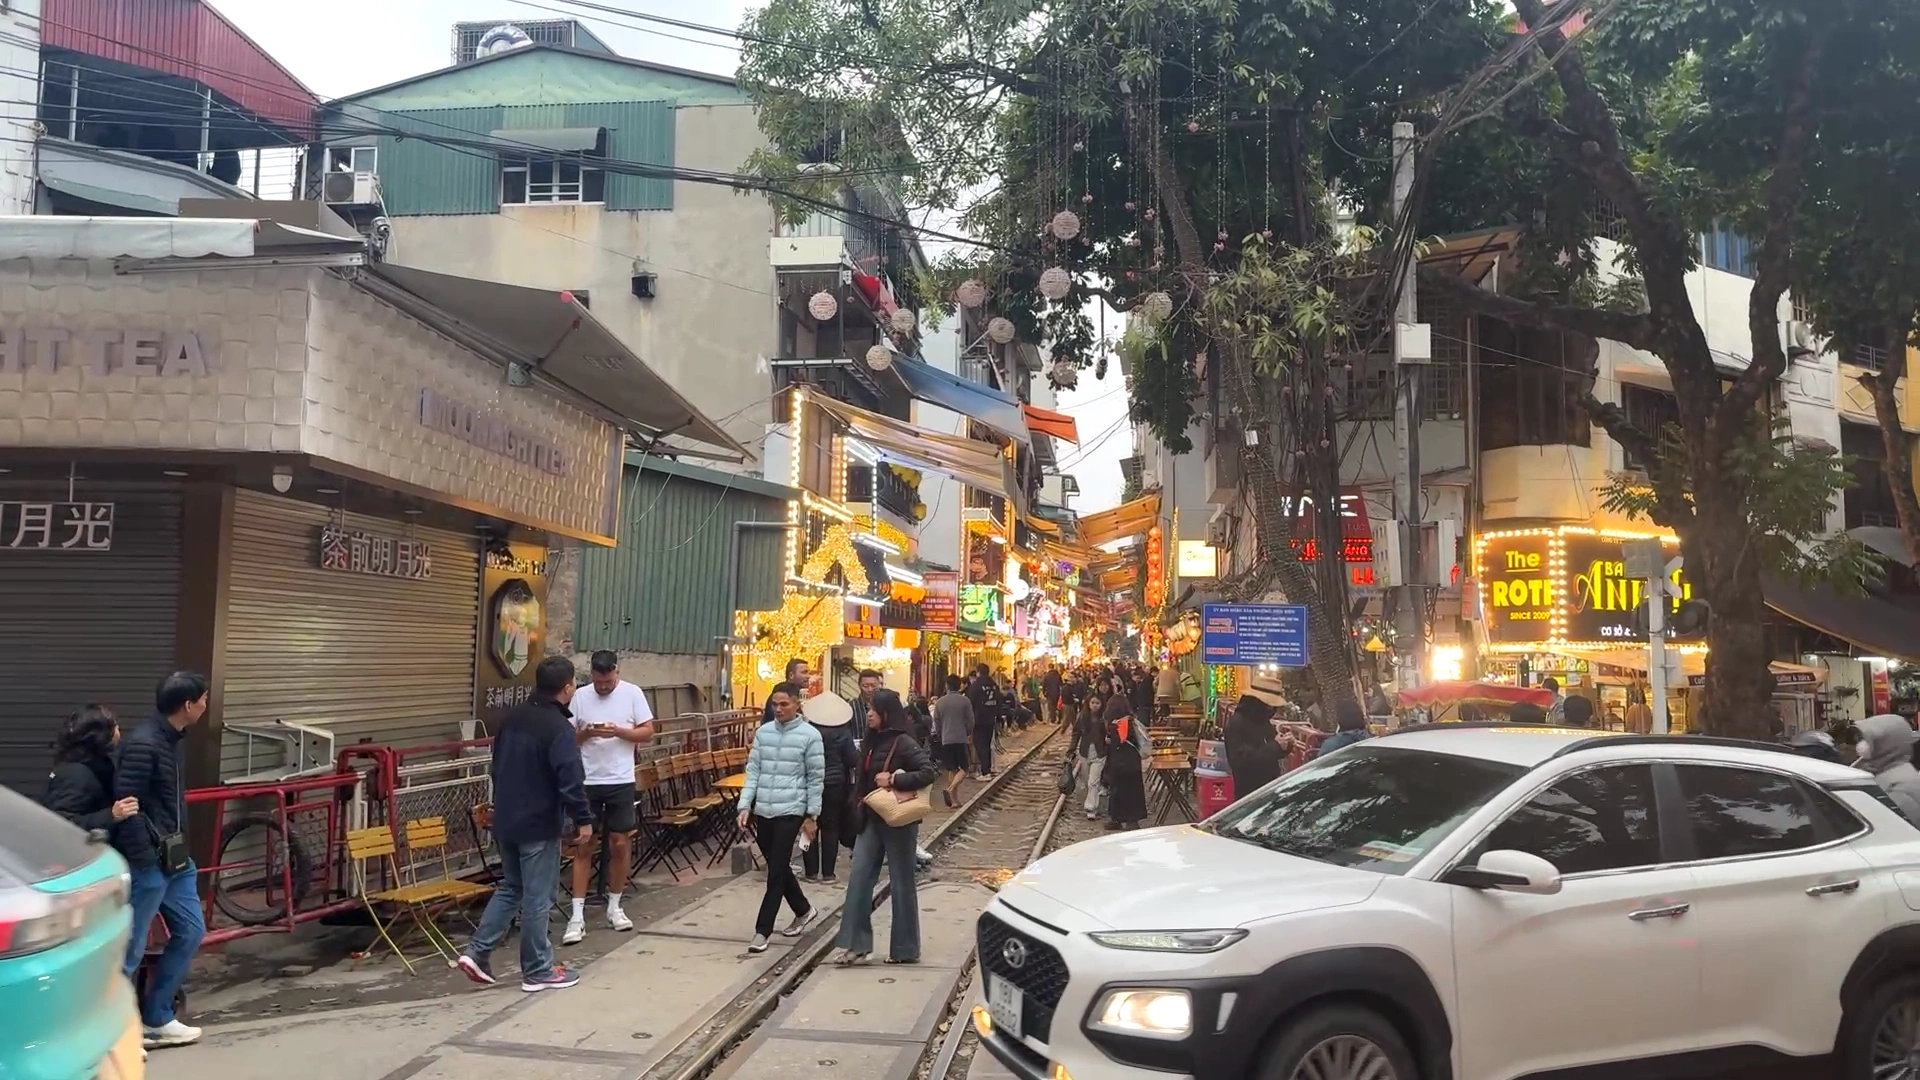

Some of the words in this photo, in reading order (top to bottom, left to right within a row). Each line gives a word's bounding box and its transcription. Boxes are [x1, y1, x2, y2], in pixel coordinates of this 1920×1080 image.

[79, 329, 208, 377] TEA
[322, 527, 431, 578] 茶前明月光
[1506, 551, 1540, 568] The
[1509, 612, 1531, 620] SINCE
